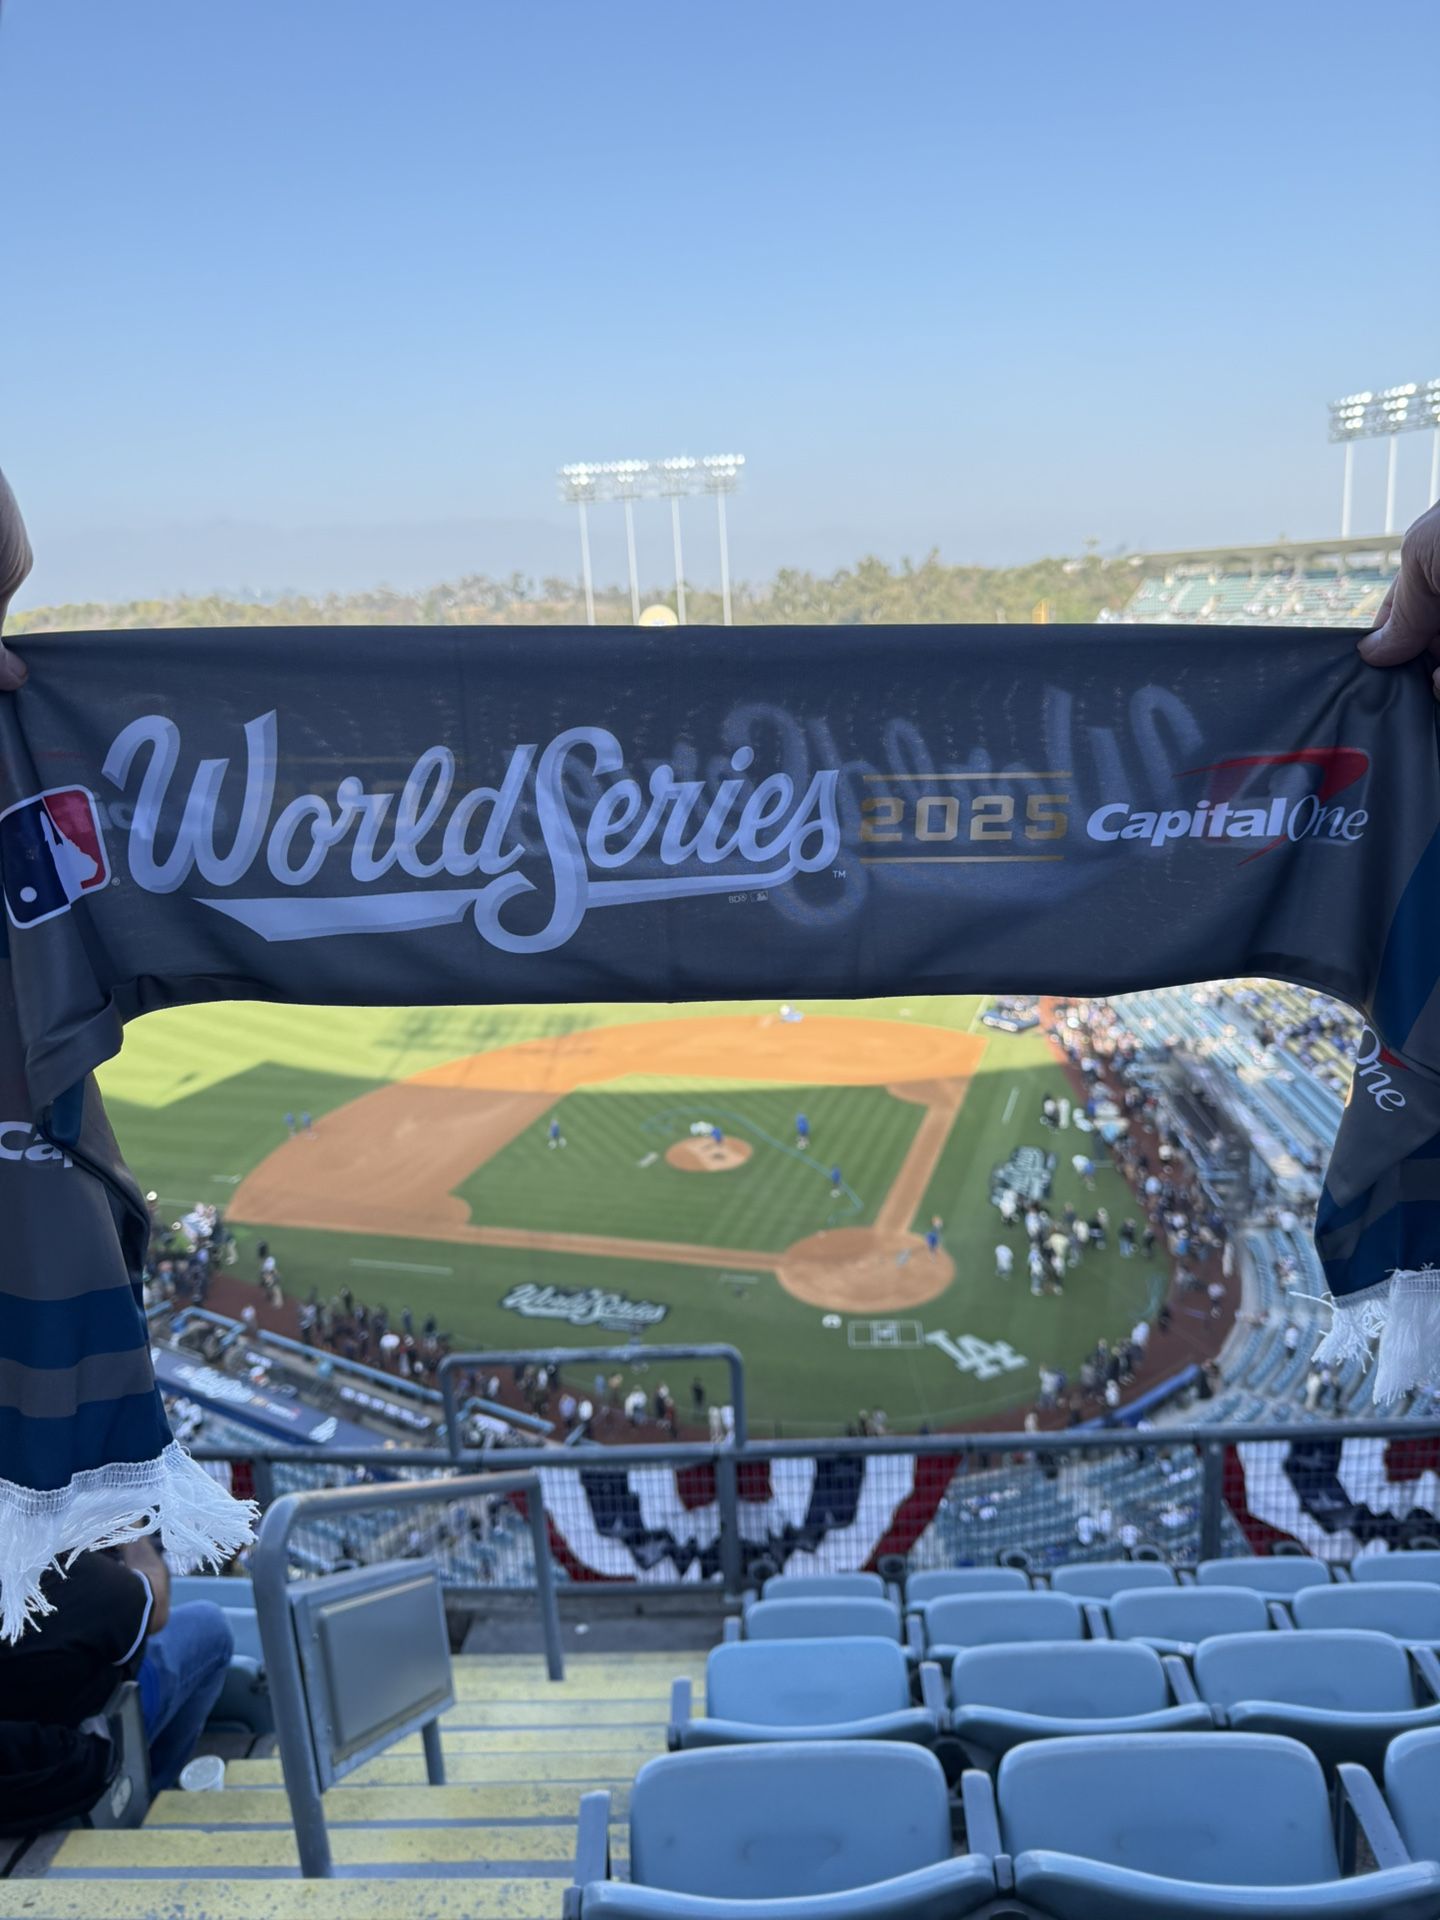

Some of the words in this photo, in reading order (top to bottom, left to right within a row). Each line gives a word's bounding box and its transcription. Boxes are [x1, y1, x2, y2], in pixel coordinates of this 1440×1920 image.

[102, 709, 537, 894] World
[474, 726, 839, 954] Series
[859, 793, 1070, 843] 2025
[1086, 797, 1288, 847] Capital
[1287, 794, 1369, 842] One
